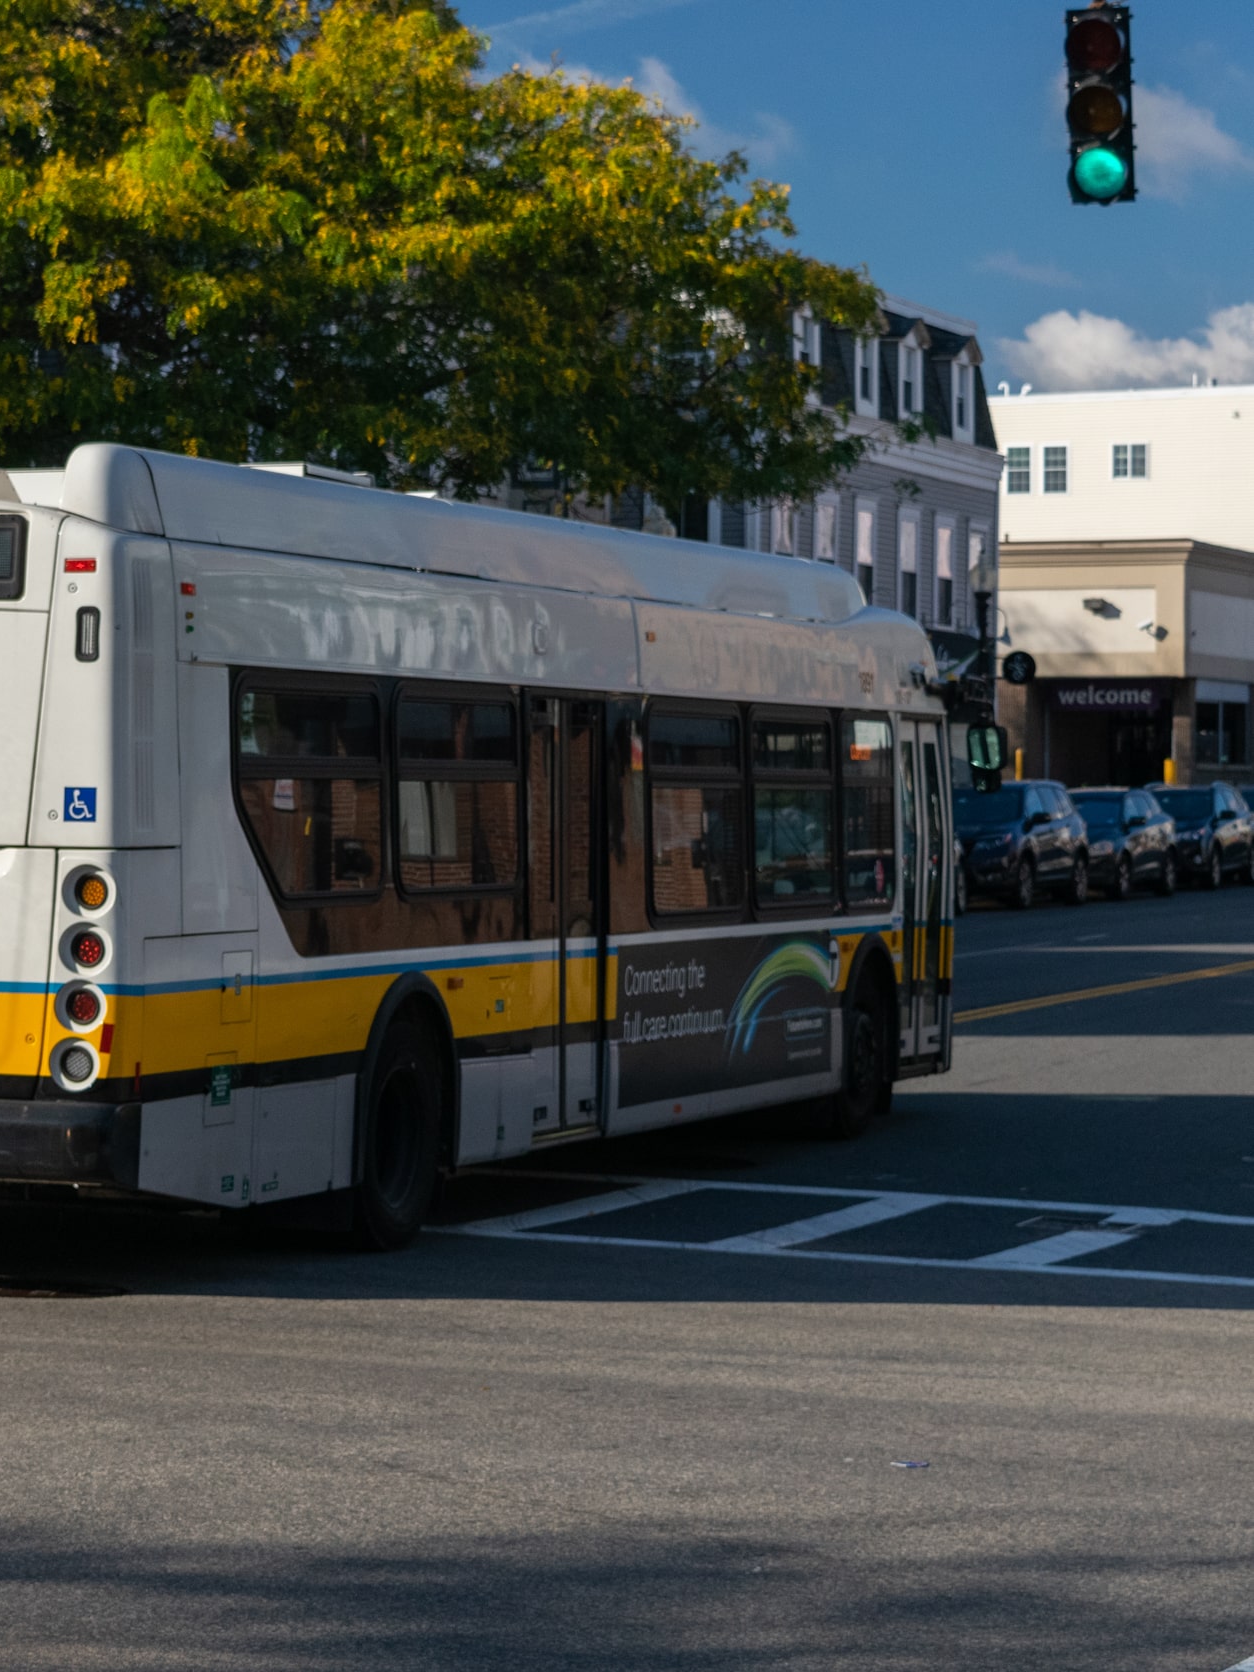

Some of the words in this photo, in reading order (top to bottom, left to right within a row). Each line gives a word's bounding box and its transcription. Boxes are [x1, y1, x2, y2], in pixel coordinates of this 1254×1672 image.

[1059, 685, 1153, 706] welcome
[625, 960, 685, 998] Connecting
[688, 958, 706, 989] the
[623, 1011, 641, 1043] full
[642, 1016, 667, 1040] care
